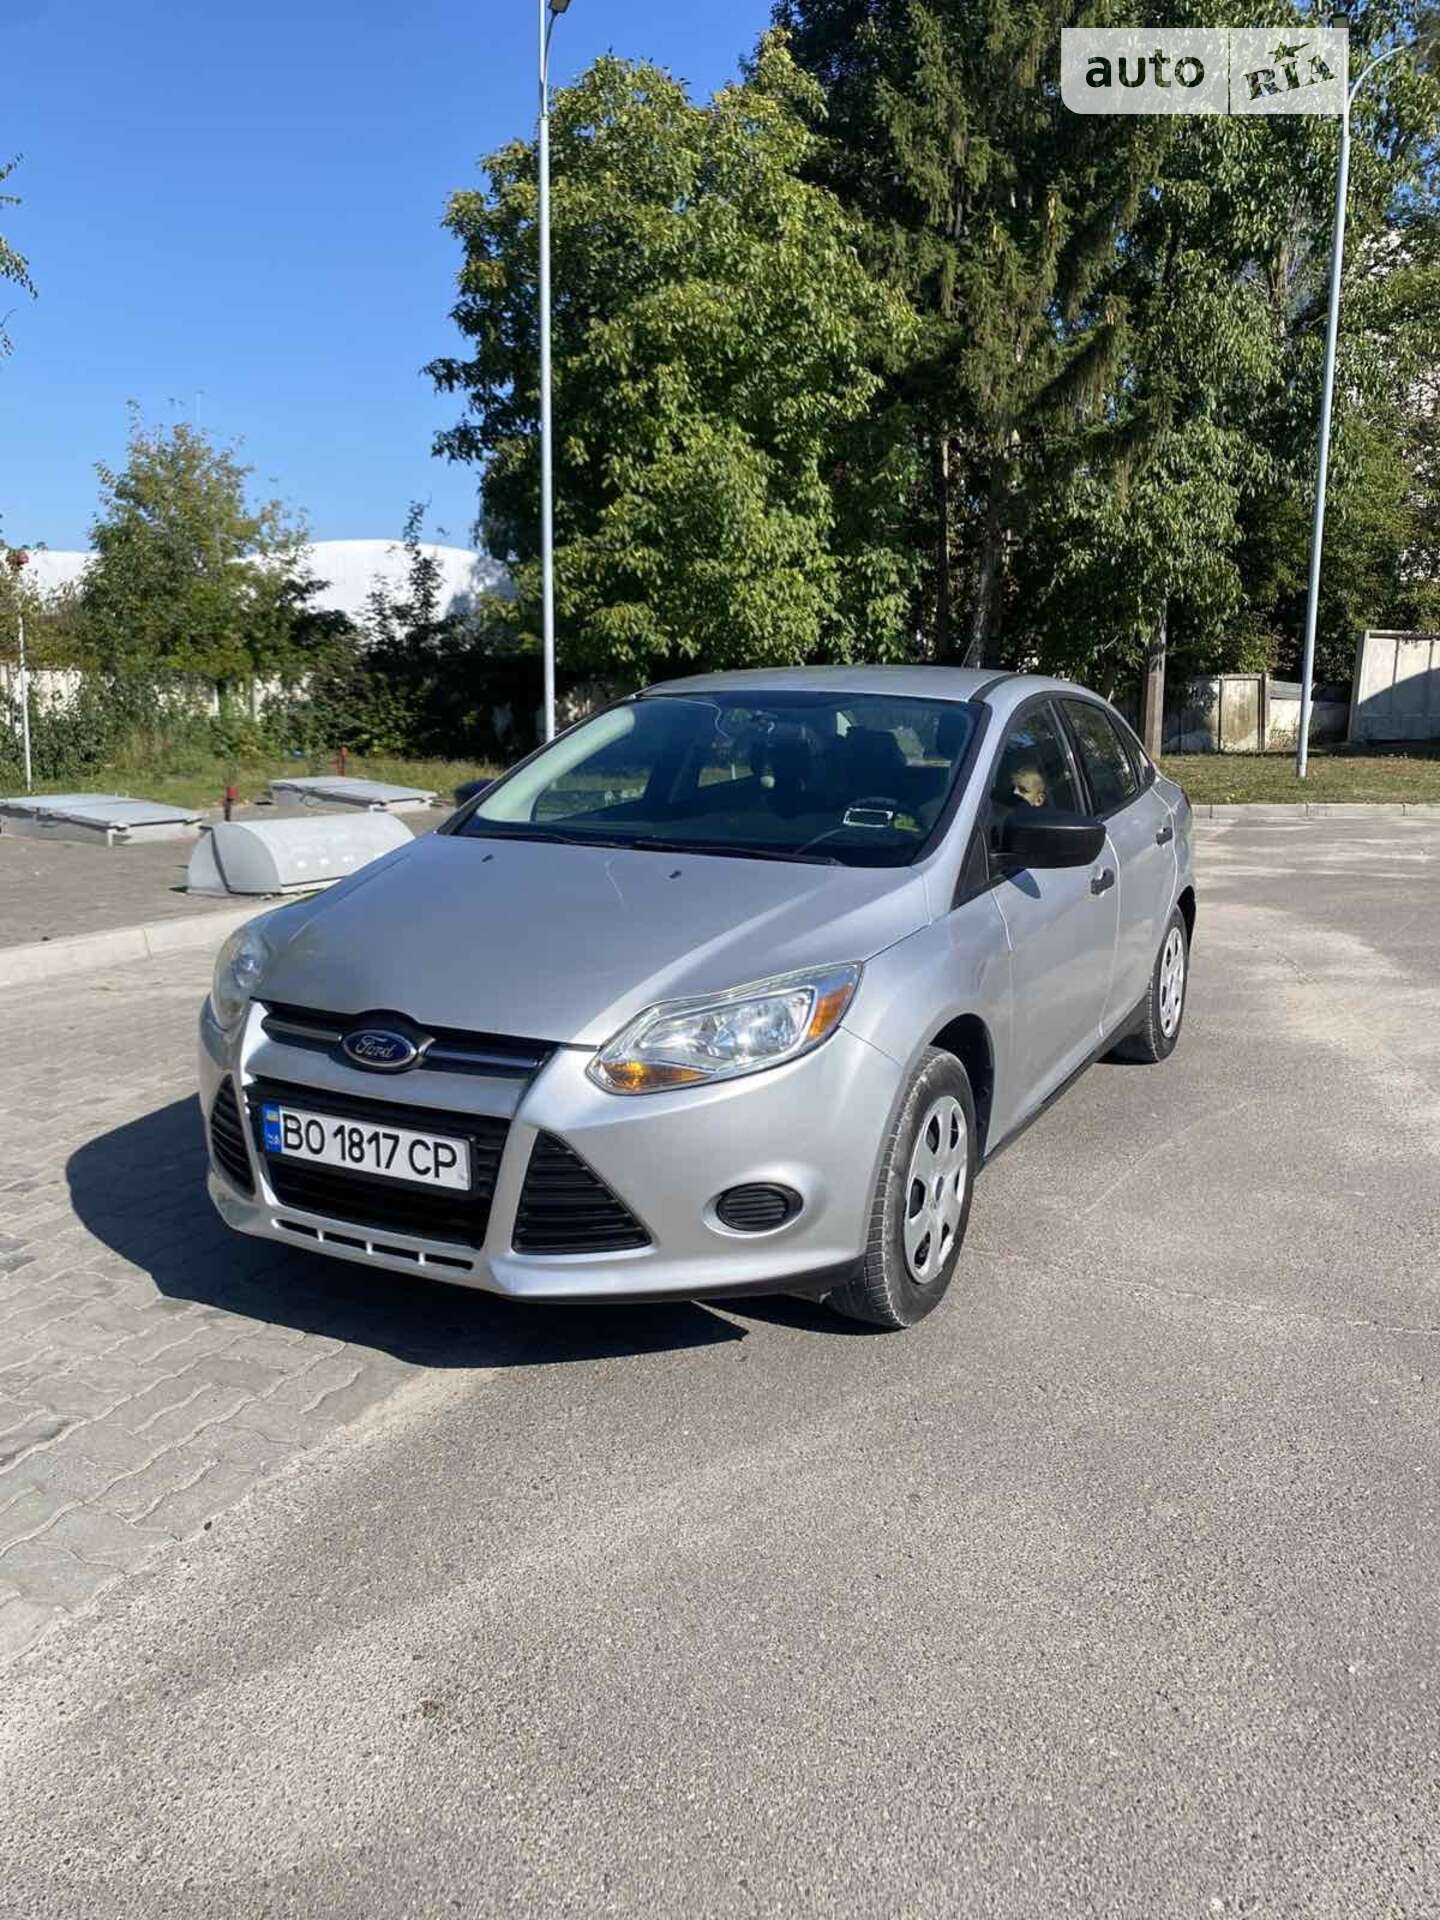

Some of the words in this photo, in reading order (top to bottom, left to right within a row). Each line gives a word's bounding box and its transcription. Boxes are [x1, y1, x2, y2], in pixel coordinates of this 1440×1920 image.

[354, 1034, 396, 1059] Ford
[283, 1113, 325, 1155] BO
[333, 1124, 400, 1170] 1817
[408, 1138, 457, 1179] CP
